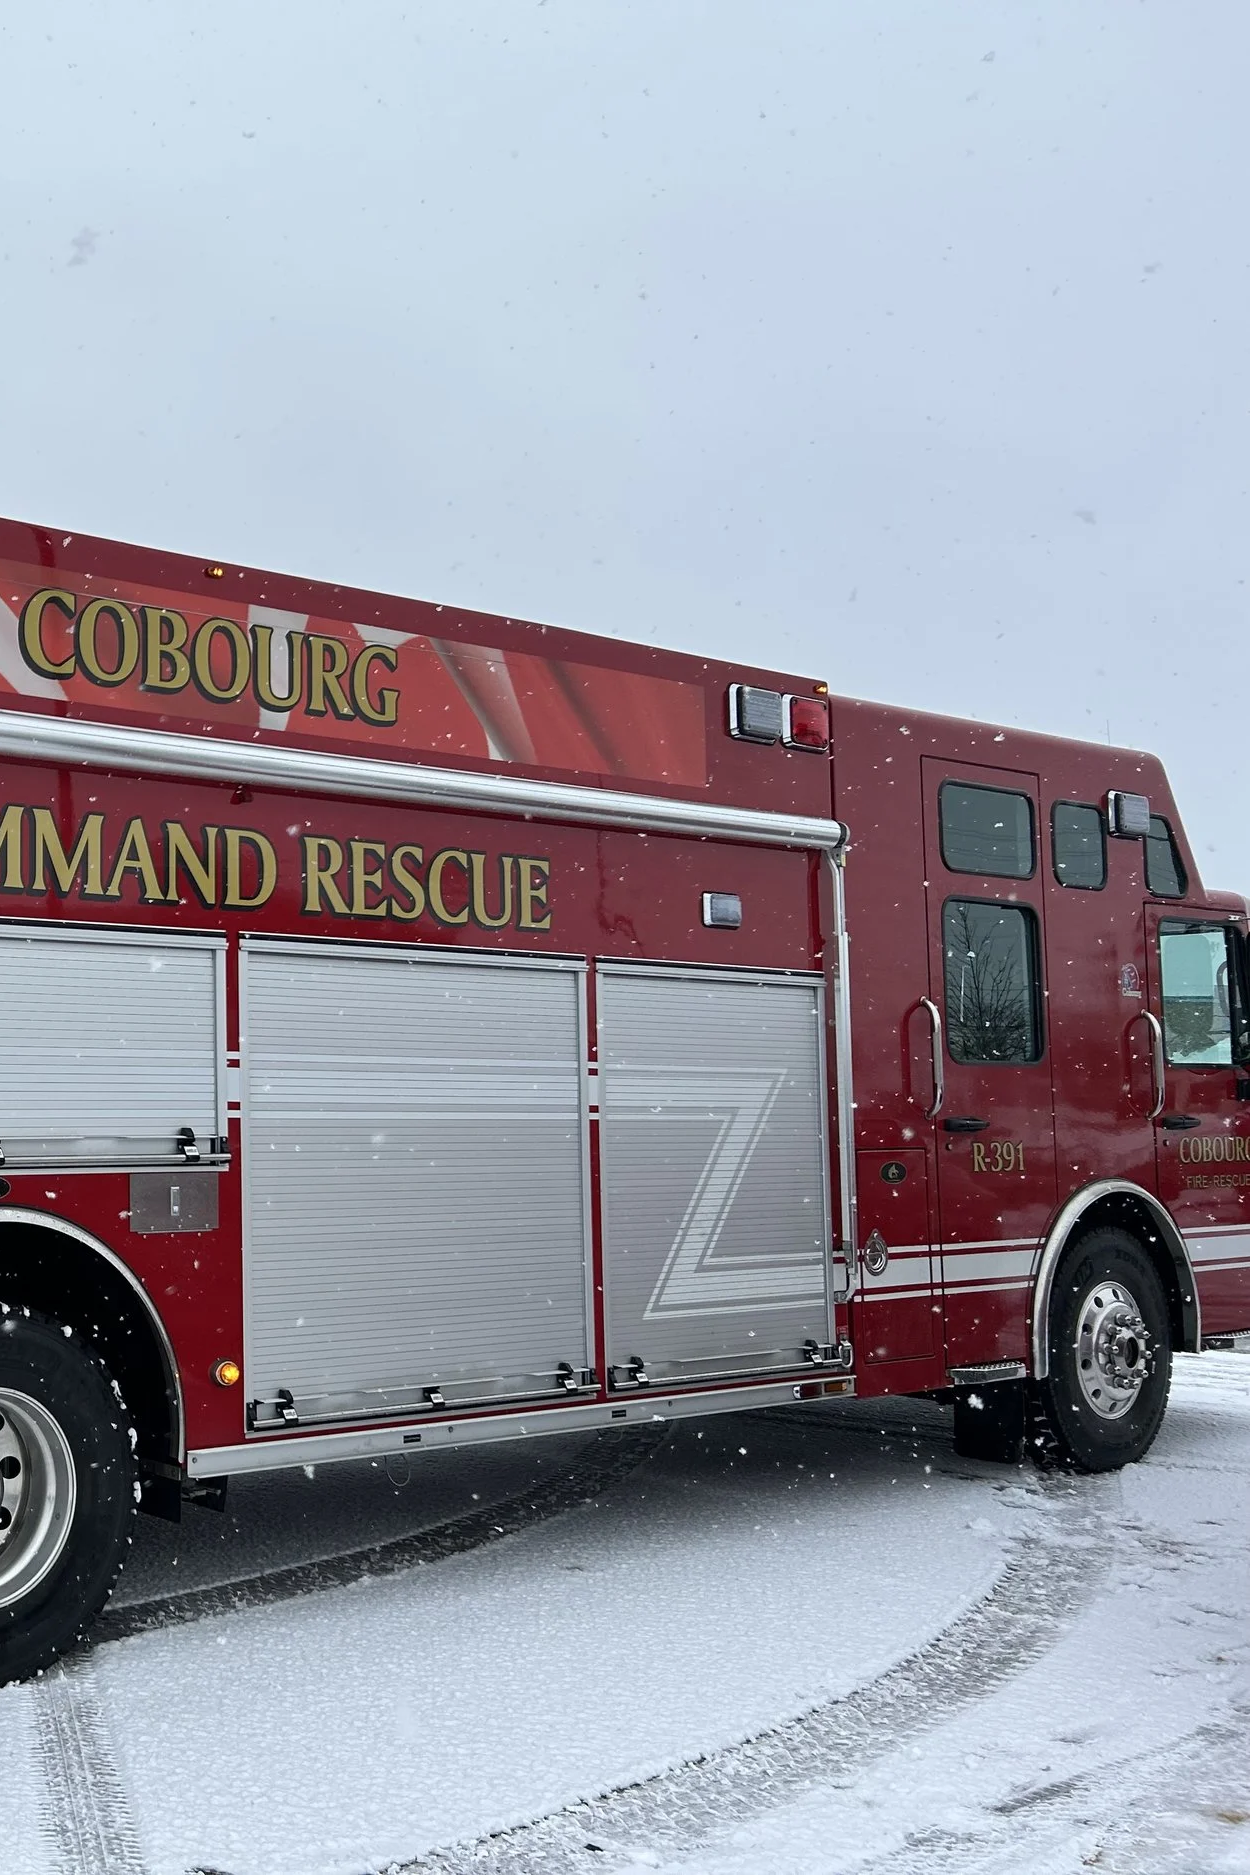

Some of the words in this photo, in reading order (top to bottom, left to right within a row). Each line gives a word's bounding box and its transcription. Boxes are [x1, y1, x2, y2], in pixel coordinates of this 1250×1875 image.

[18, 587, 401, 727] COBOURG
[300, 834, 551, 932] RESCUE
[972, 1140, 1025, 1172] R-391
